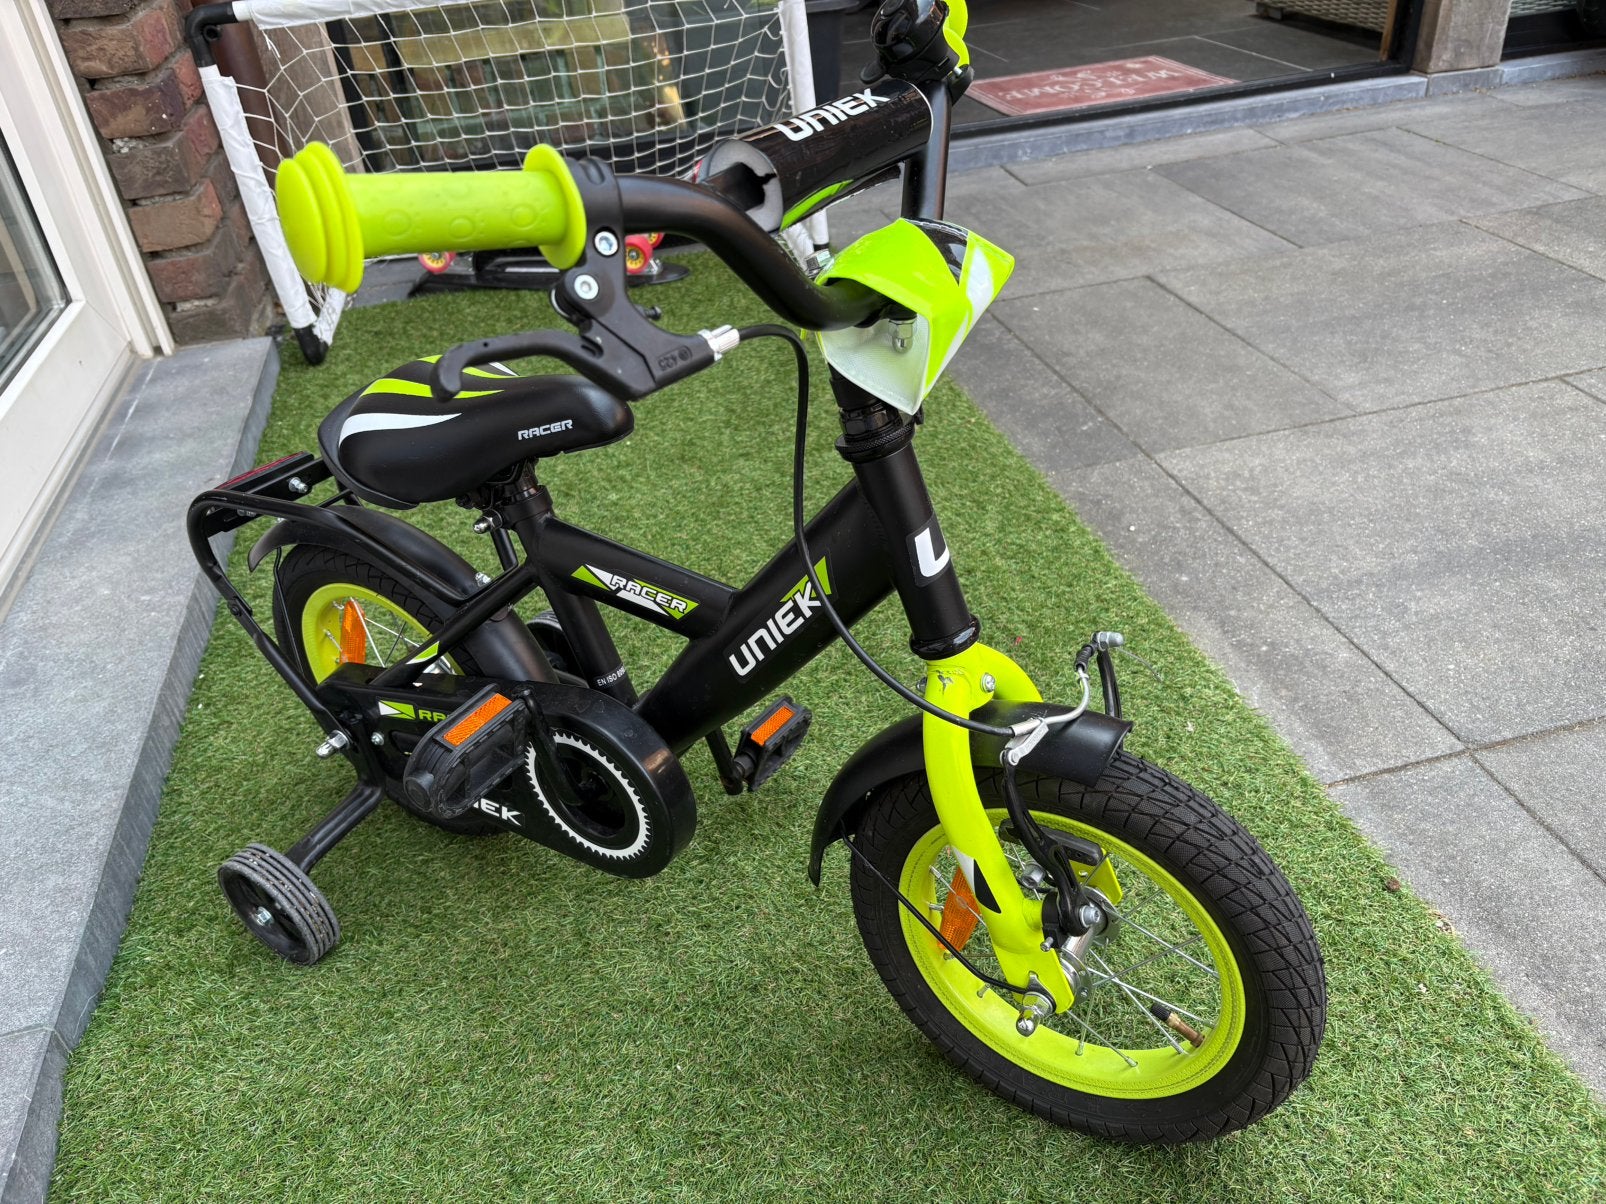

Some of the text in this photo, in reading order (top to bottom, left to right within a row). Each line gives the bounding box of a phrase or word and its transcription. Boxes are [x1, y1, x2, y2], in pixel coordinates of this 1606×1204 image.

[998, 69, 1183, 101] WELCOME
[773, 87, 891, 142] UNIEK
[517, 419, 573, 441] RACER
[610, 574, 688, 613] RACER
[728, 581, 822, 677] UNIEK
[596, 675, 606, 687] EN
[606, 673, 618, 683] ISO
